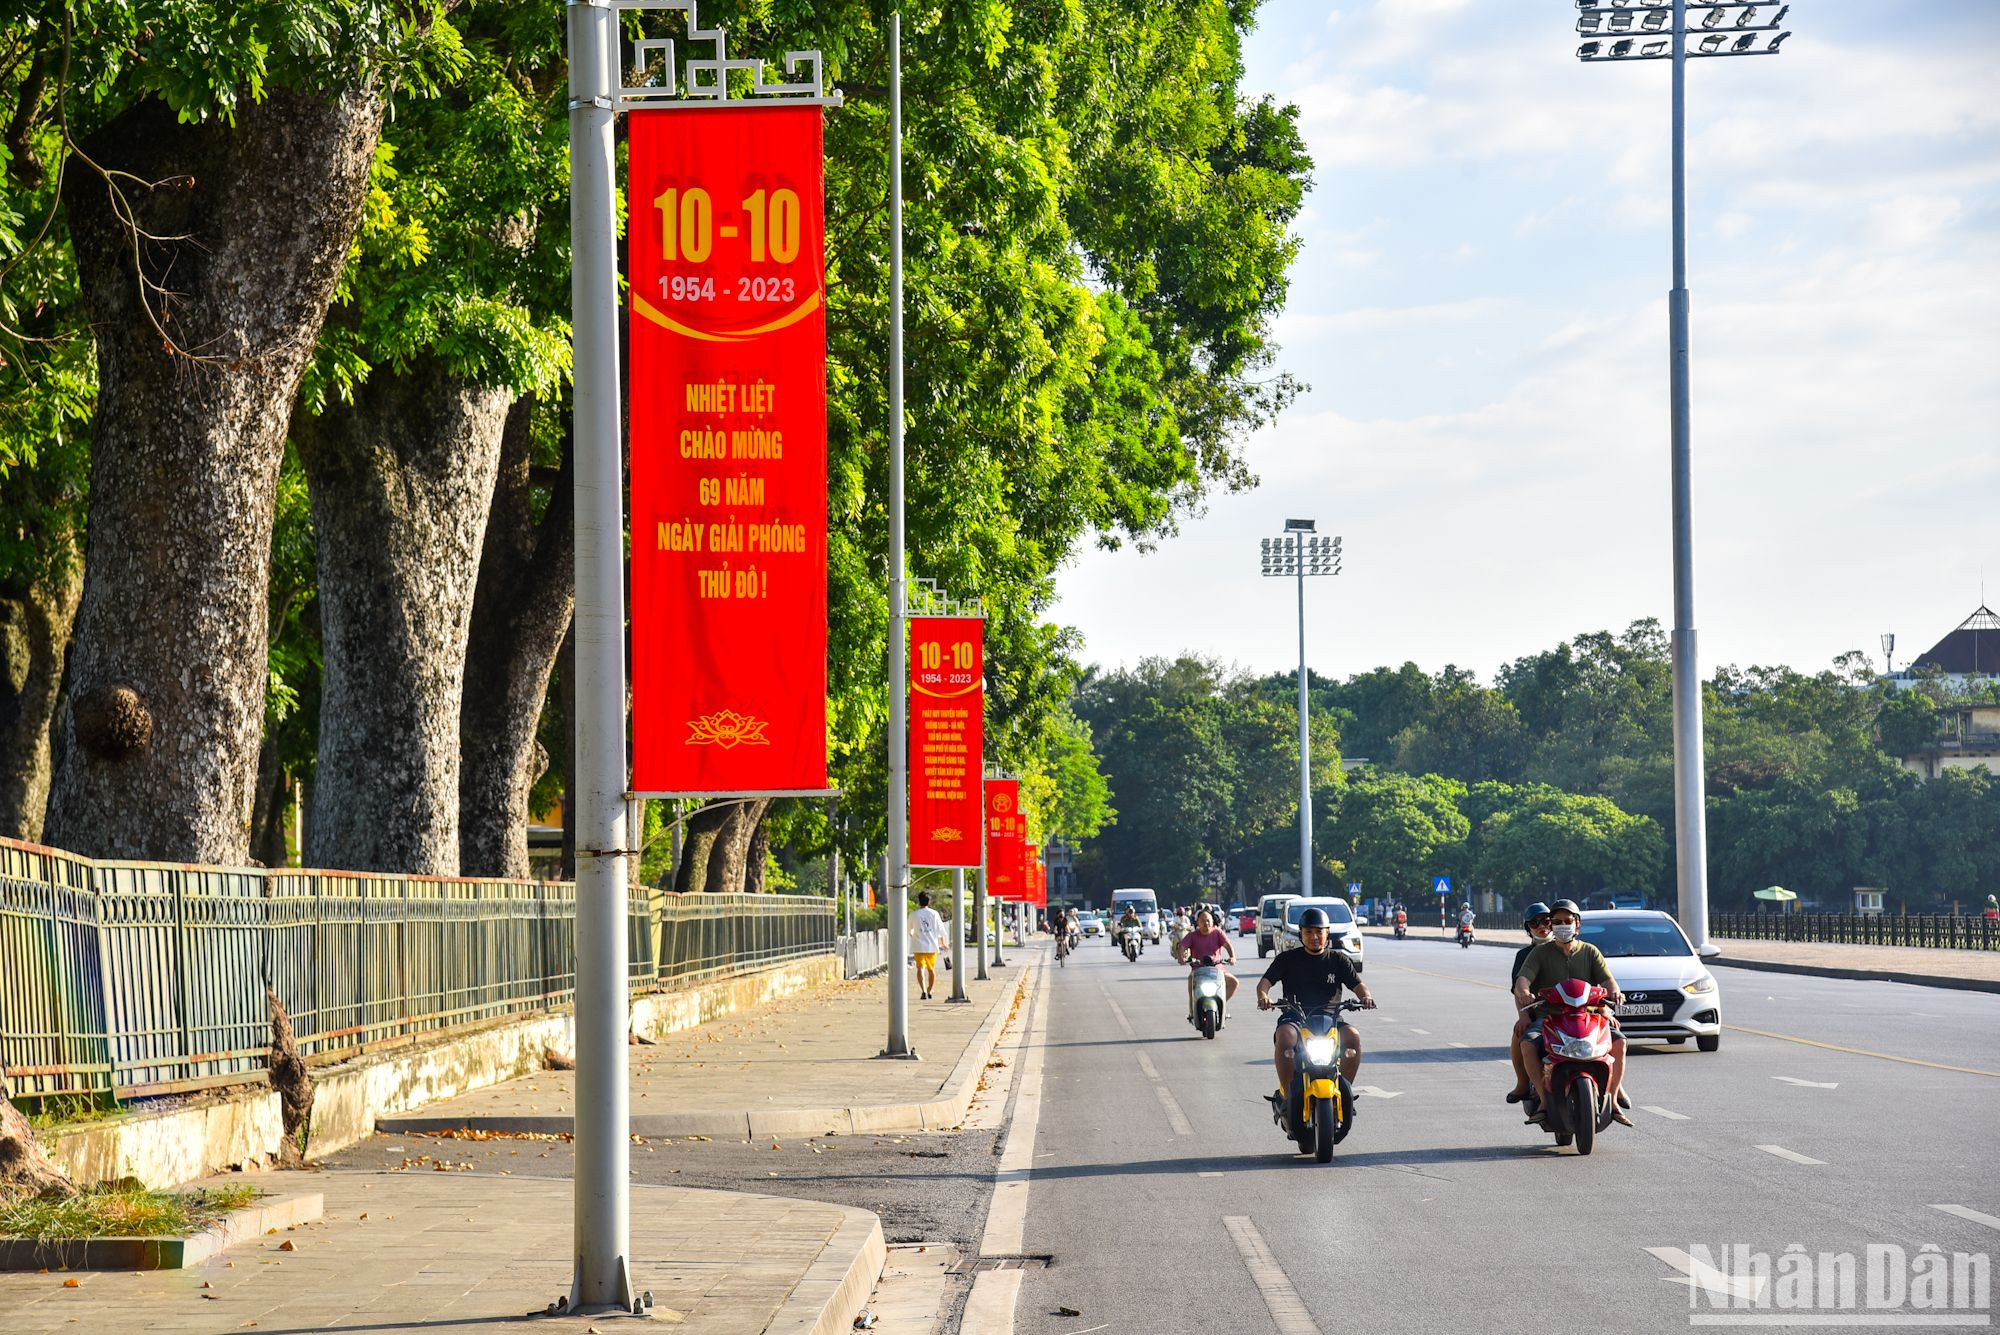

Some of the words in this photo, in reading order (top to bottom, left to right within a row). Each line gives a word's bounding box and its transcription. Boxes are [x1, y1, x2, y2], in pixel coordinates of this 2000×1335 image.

[658, 275, 716, 302] 1954
[737, 276, 795, 303] 2023
[686, 378, 737, 419] NHIỆT
[741, 378, 775, 419] LIỆT
[680, 425, 727, 460] CHÀO
[731, 425, 783, 460] MỪNG
[699, 477, 721, 506] 69
[725, 471, 765, 506] NĂM
[657, 517, 705, 552] NGÀY
[709, 515, 744, 553] GIẢI
[748, 518, 806, 553] PHÓNG
[698, 561, 731, 599] THỦ
[921, 673, 942, 684] 1954
[949, 673, 972, 684] 2023
